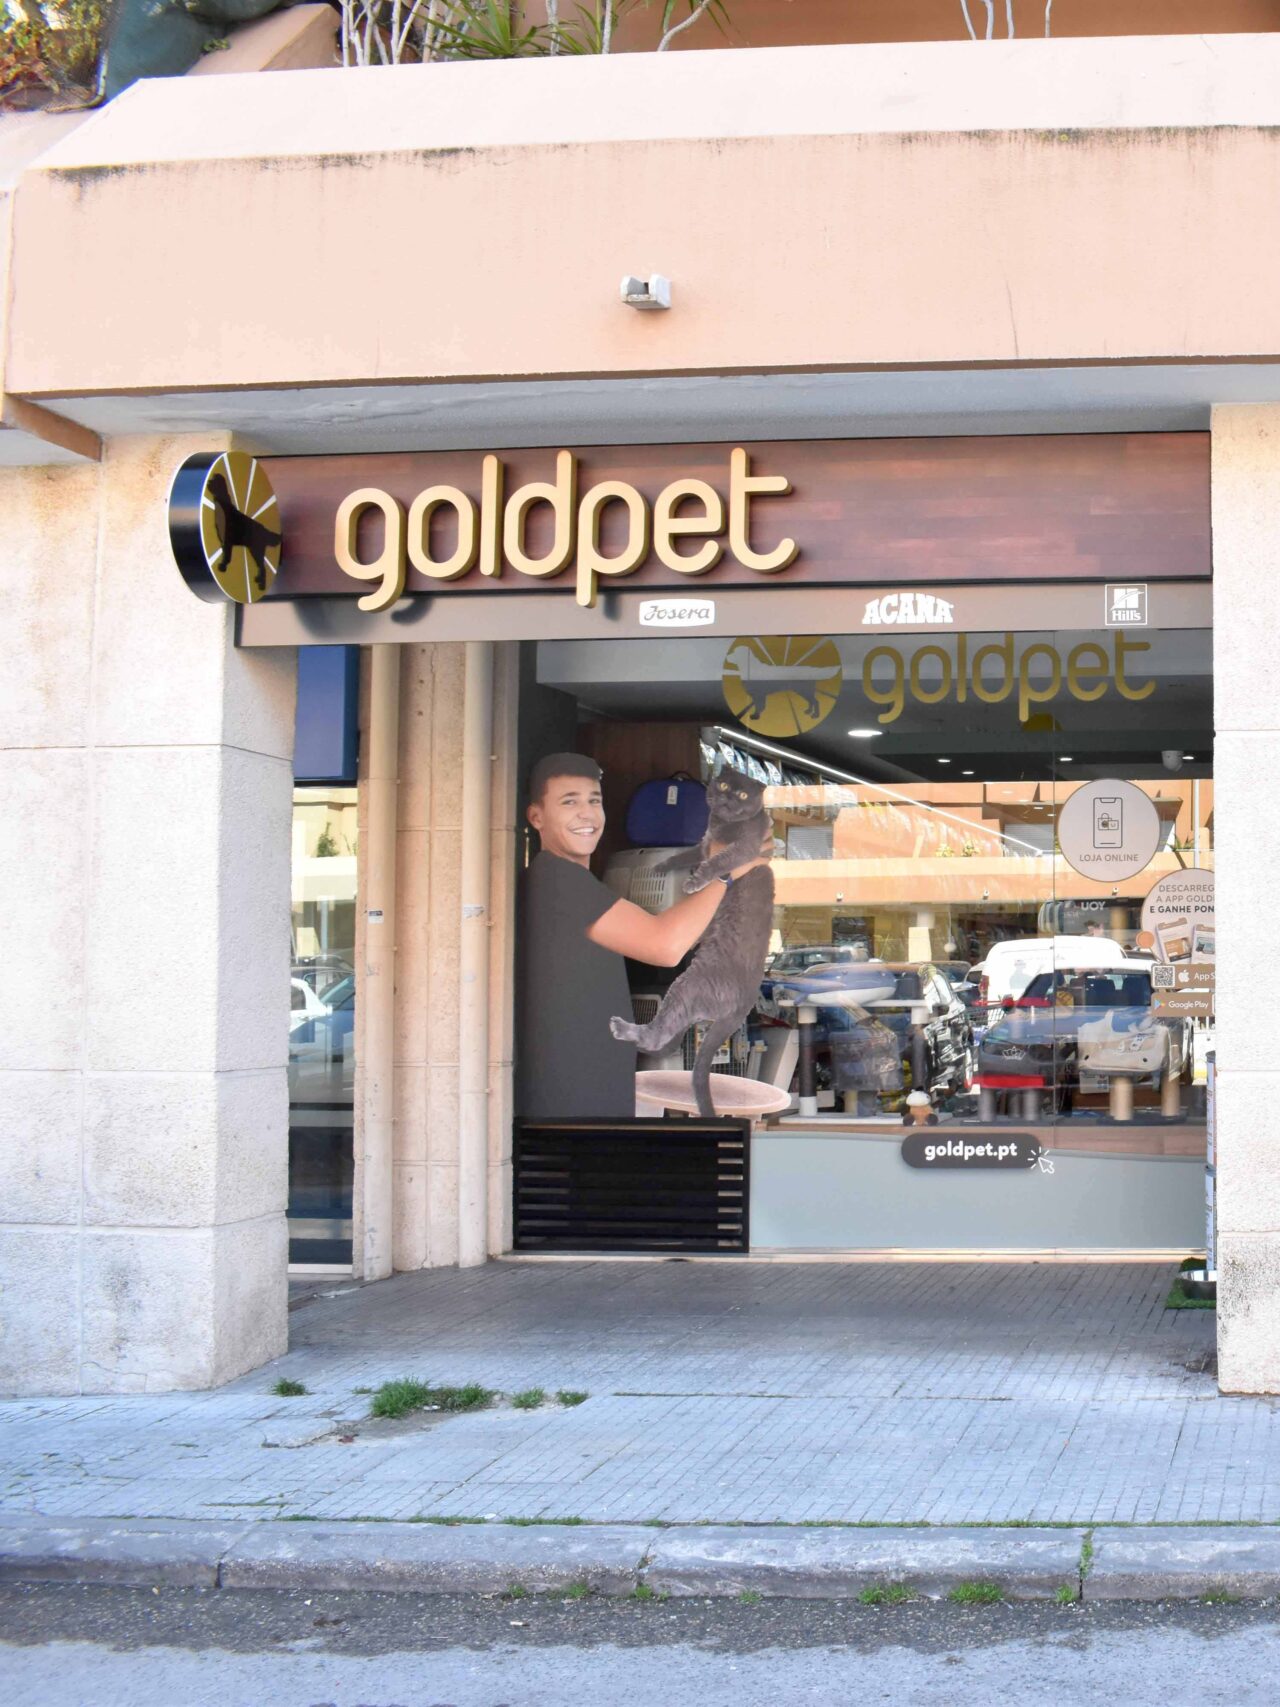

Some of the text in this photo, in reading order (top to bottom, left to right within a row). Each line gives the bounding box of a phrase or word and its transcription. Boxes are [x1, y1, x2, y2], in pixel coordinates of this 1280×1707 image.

[334, 447, 800, 612] goldpet
[643, 604, 711, 622] Josera
[861, 592, 953, 625] ACANA
[861, 629, 1156, 724] goldpet
[1079, 853, 1139, 863] LOJA ONLINE
[1158, 884, 1216, 893] DESCARREG
[1165, 895, 1184, 903] APP
[1186, 894, 1216, 903] GOLD
[1149, 905, 1215, 913] E GANHE PON
[1194, 972, 1210, 982] App
[1168, 1000, 1209, 1010] Google Play
[924, 1140, 1018, 1161] goldpet.pt
